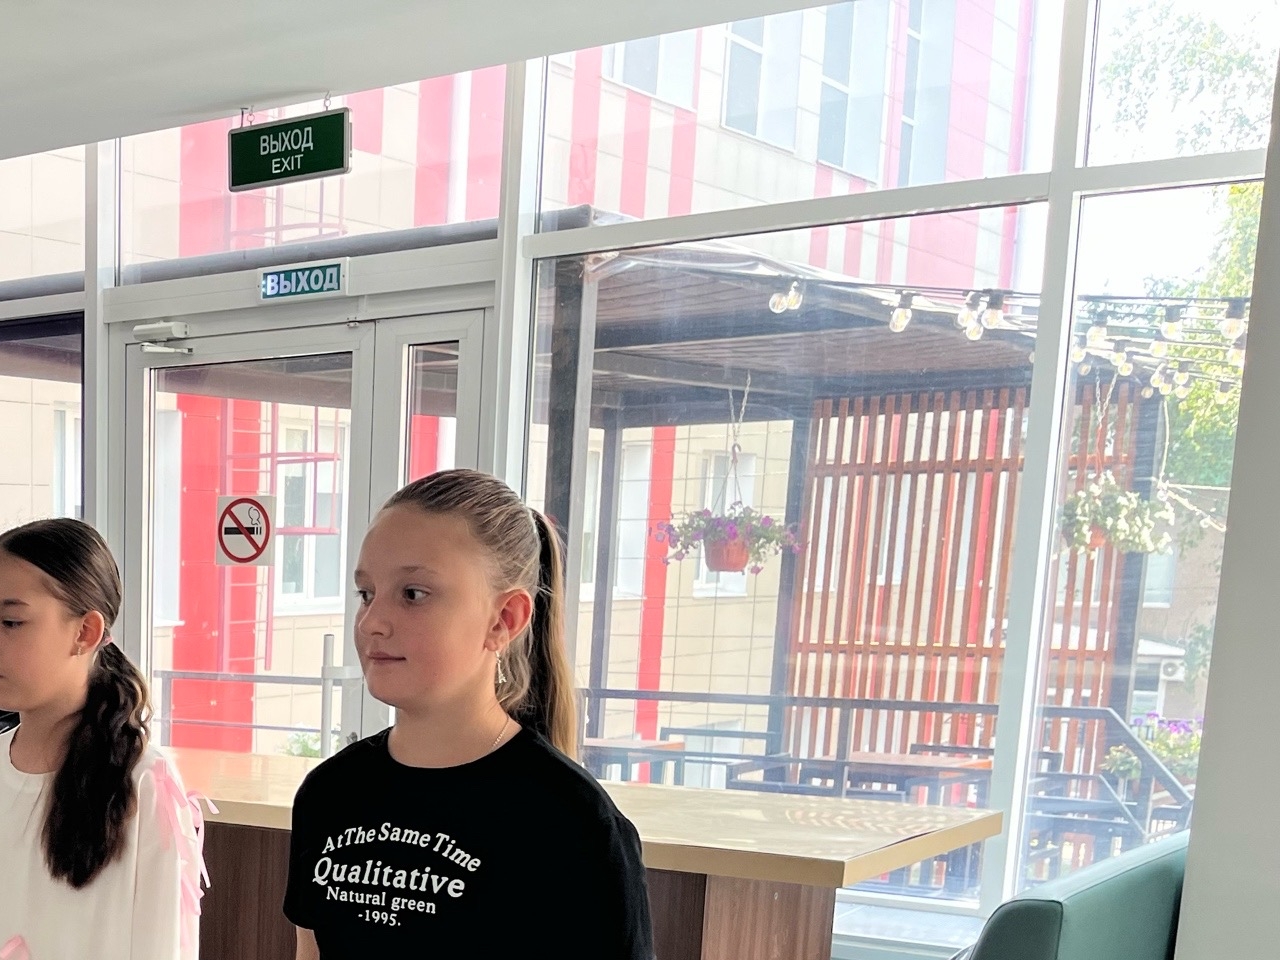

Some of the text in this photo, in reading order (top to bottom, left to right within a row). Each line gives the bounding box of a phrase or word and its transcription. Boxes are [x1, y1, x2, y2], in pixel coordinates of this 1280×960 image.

[260, 126, 314, 156] ВЫХОД
[271, 154, 304, 174] EXIT
[266, 267, 339, 296] ВЫХОД
[322, 822, 482, 872] At The Same Time
[312, 856, 466, 898] Qualitative
[326, 886, 436, 914] Natural green
